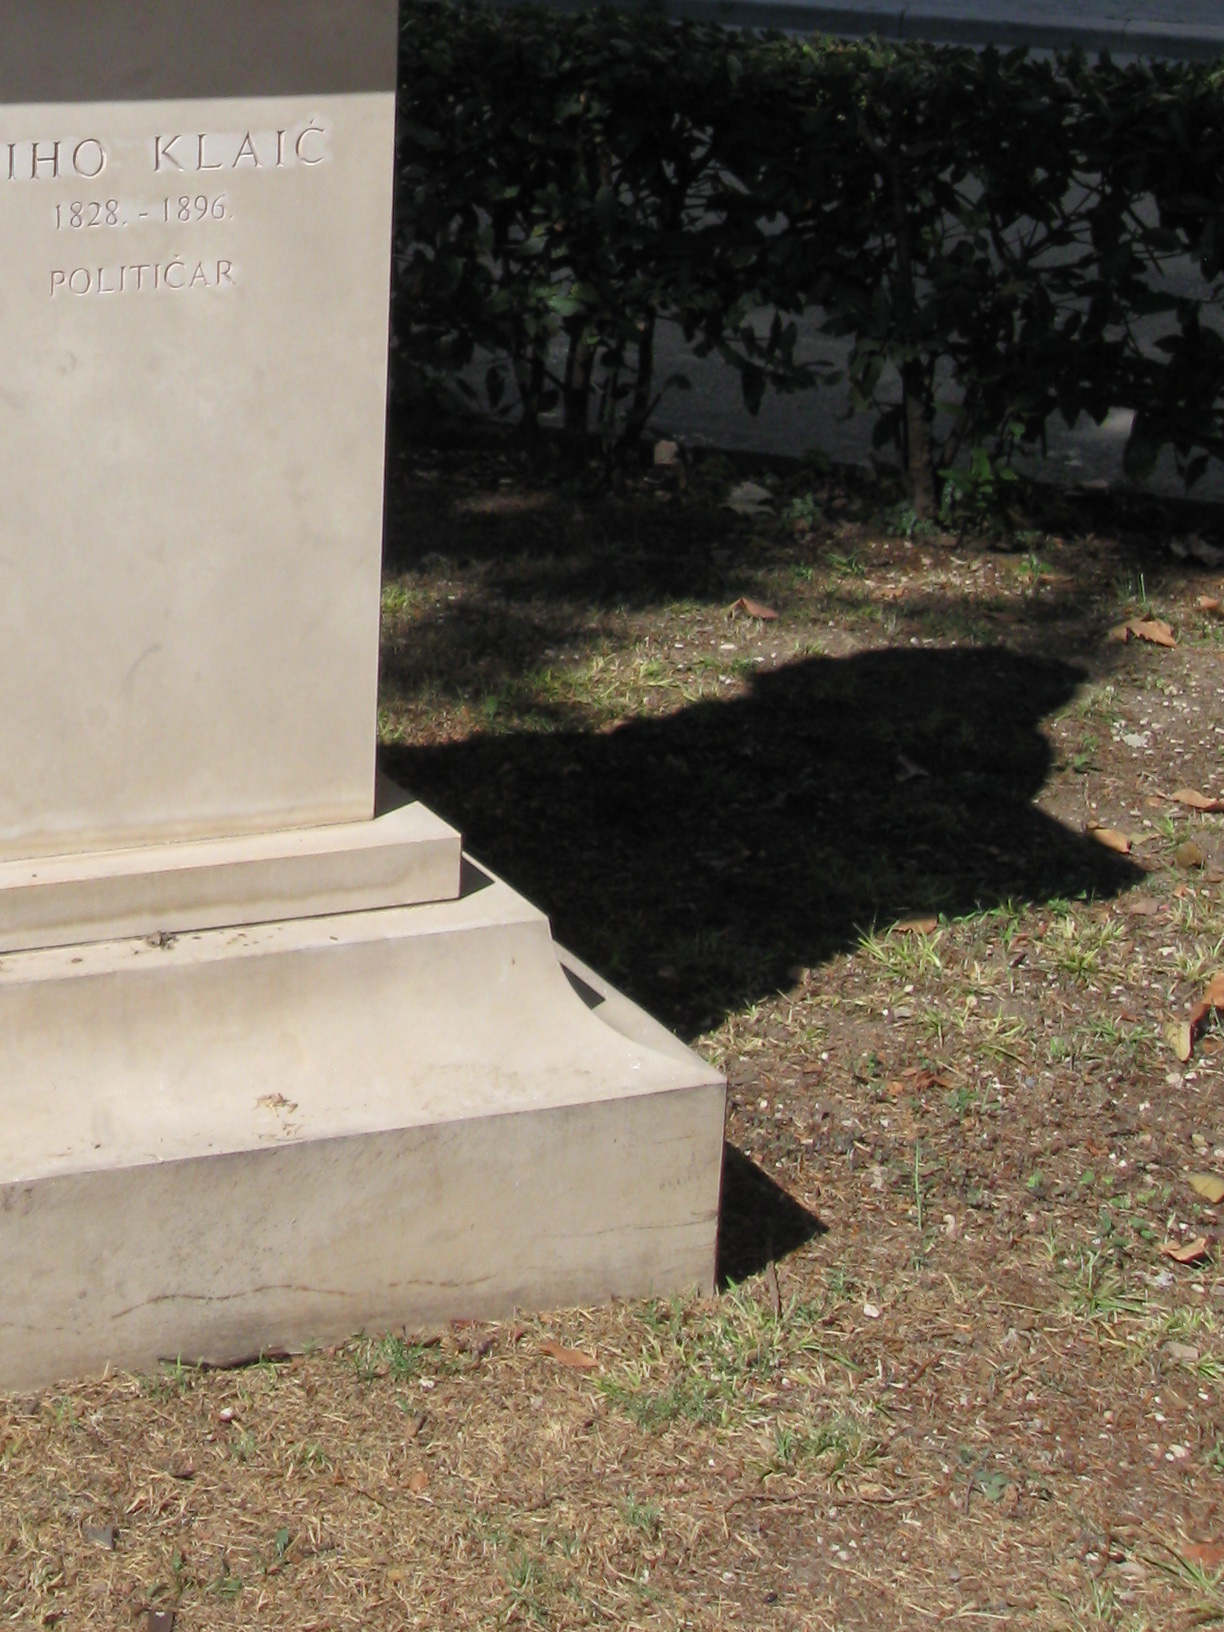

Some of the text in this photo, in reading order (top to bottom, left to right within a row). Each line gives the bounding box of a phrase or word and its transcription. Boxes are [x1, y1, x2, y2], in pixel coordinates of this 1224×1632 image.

[153, 119, 327, 173] KLAIĆ
[161, 193, 234, 224] 1896.
[49, 253, 237, 297] POLITIČAR
